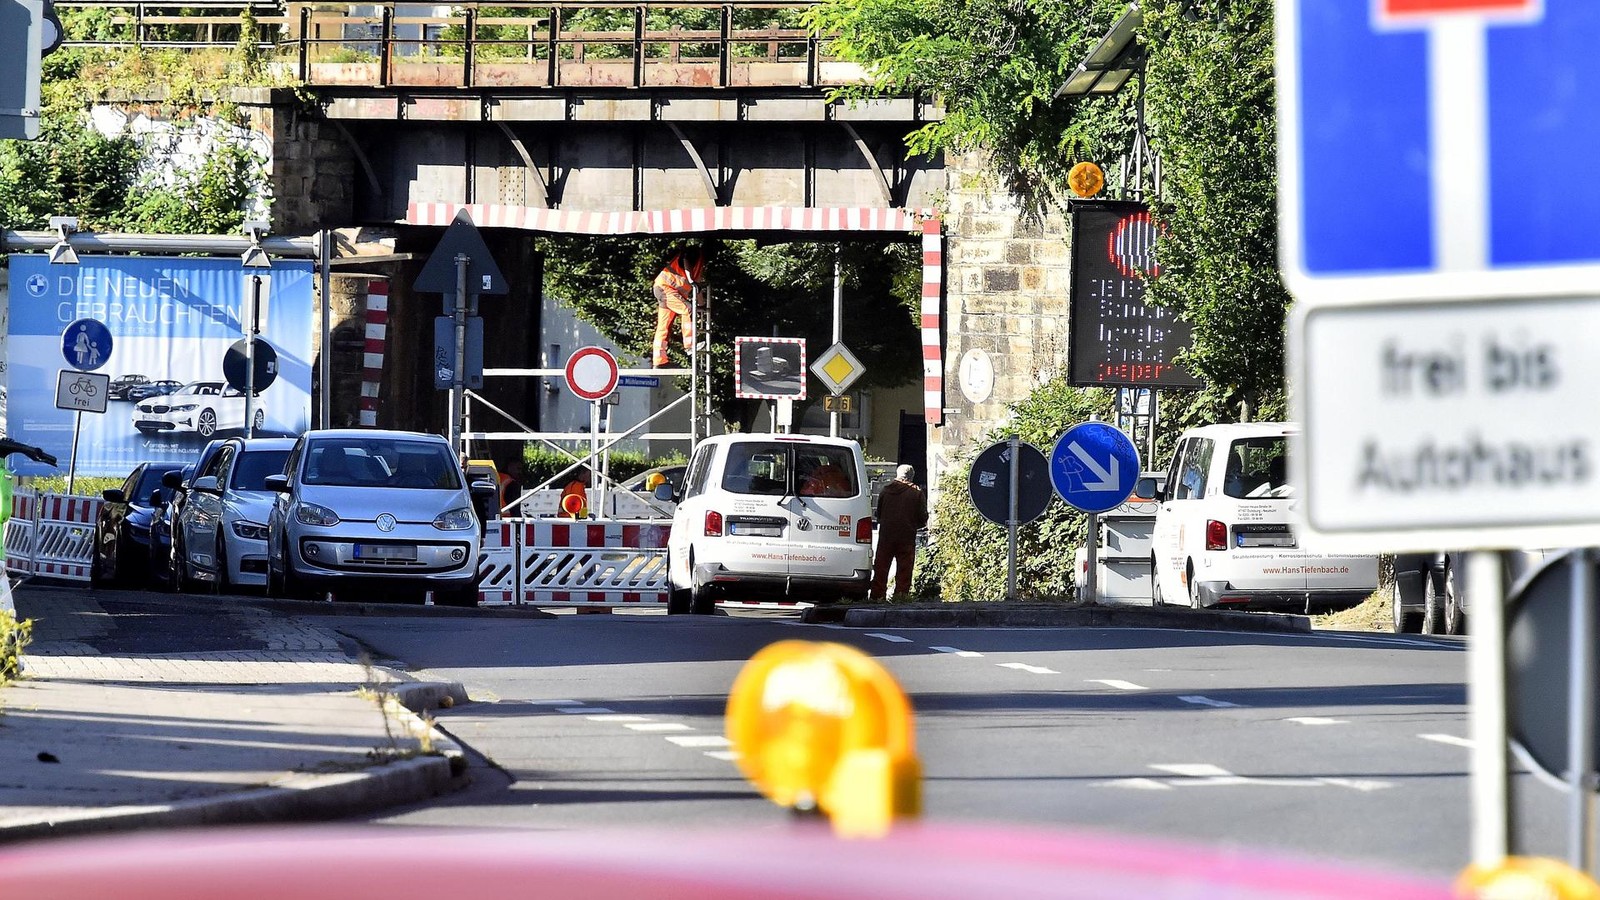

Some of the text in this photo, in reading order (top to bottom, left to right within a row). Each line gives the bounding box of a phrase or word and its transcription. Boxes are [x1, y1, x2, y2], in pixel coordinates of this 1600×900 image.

[58, 276, 97, 297] DIE
[105, 276, 189, 298] NEUEN
[57, 301, 242, 325] GEBRAUCHTEN
[1380, 327, 1561, 396] frei bis
[73, 397, 91, 408] frei
[826, 398, 848, 410] 26
[1355, 430, 1592, 494] Autohaus
[751, 552, 827, 563] www.HansTiefenbach.de
[1262, 565, 1350, 575] www.HansTiefenbach.de
